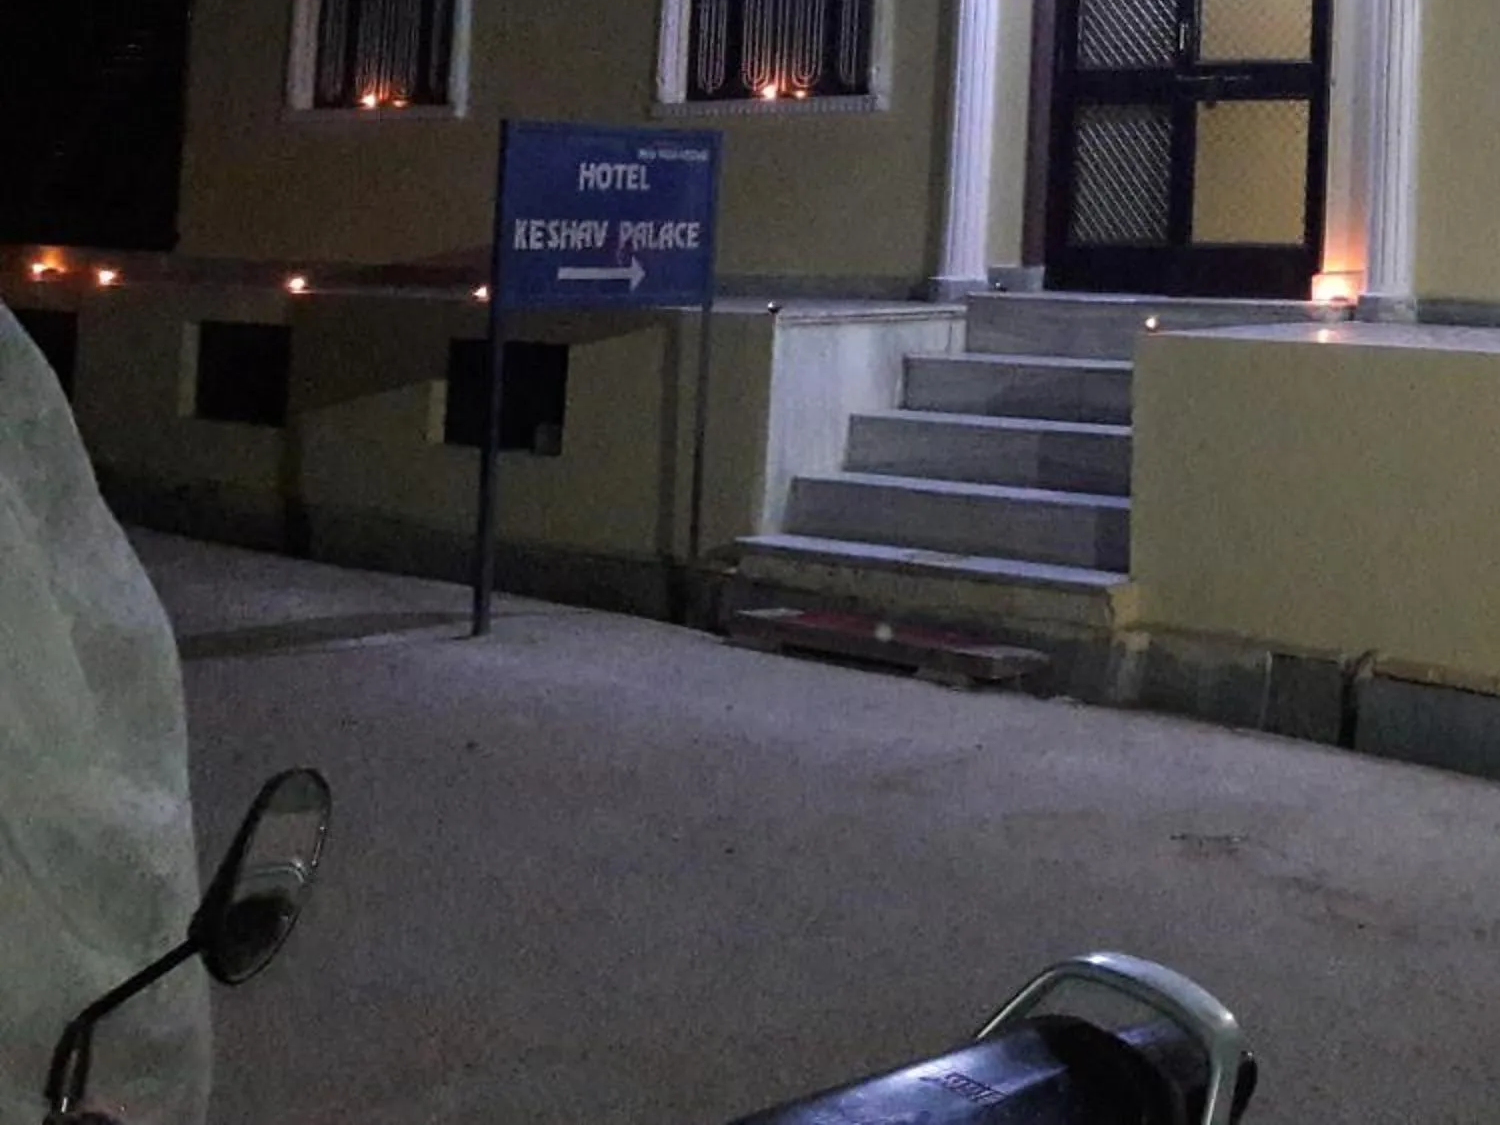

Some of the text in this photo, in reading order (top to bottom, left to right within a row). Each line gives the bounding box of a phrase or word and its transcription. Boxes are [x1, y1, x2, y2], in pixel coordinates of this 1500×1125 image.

[578, 162, 650, 191] HOTEL
[513, 219, 700, 252] KESHAV PALACE
